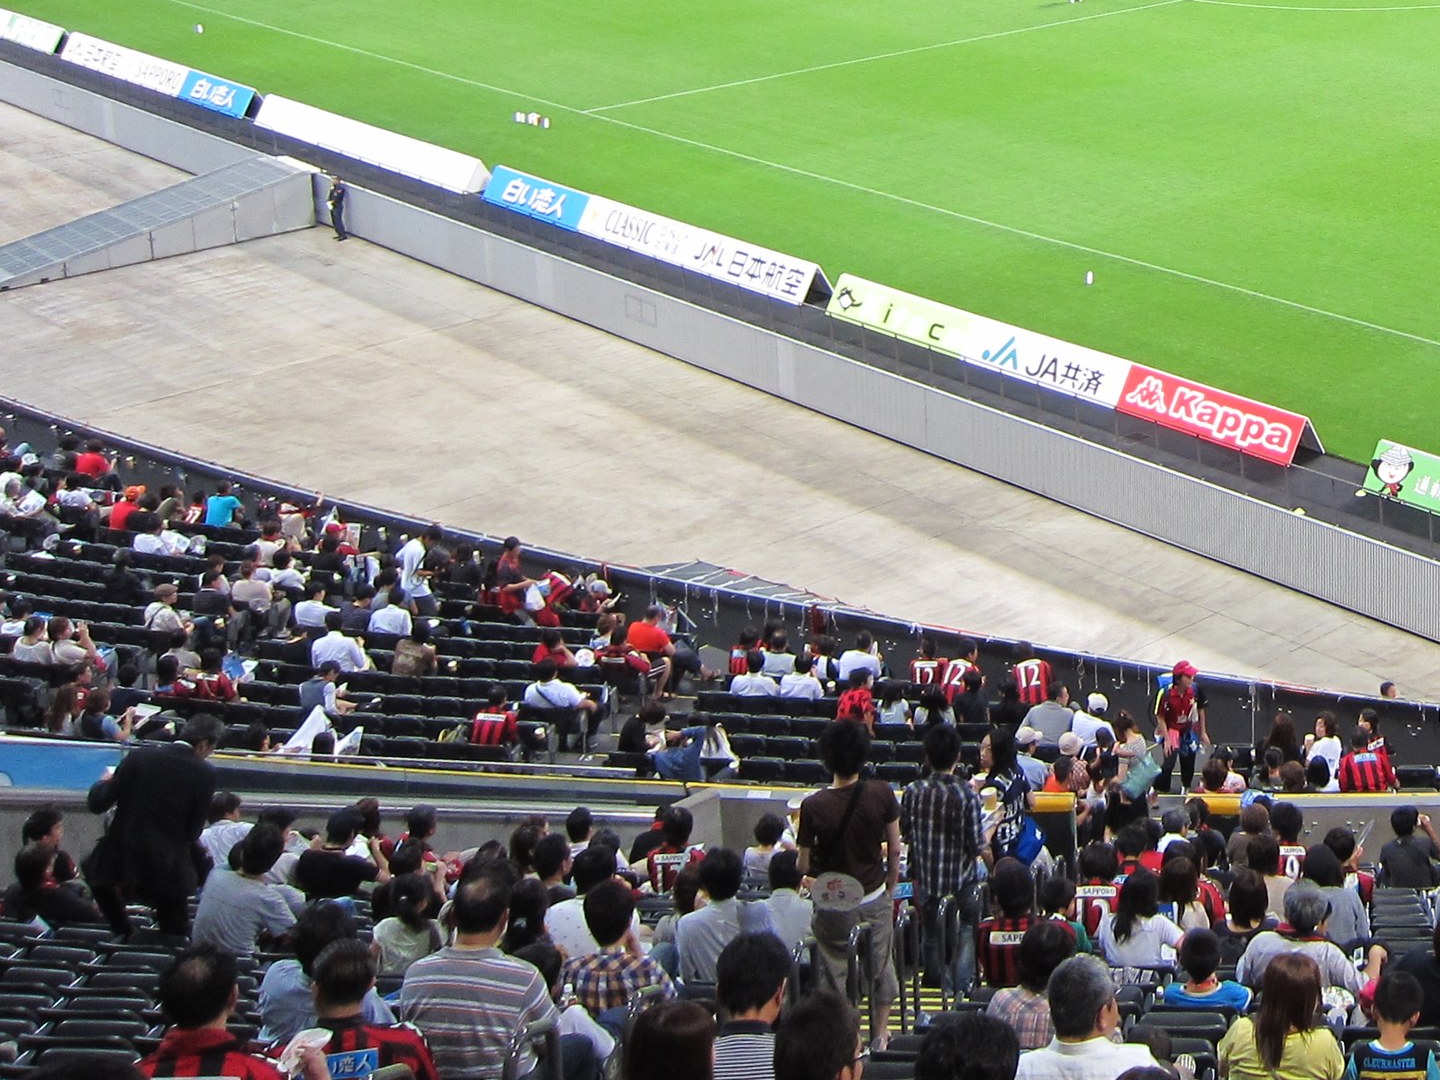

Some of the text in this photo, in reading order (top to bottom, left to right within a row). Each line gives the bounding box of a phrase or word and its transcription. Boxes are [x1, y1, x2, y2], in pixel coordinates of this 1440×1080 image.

[604, 208, 658, 247] CLASSIC
[727, 249, 805, 296] 日本航空
[1026, 354, 1105, 396] JA共済
[1168, 386, 1293, 453] Kappa
[1019, 664, 1041, 688] 12
[1082, 886, 1115, 896] SAPPORO
